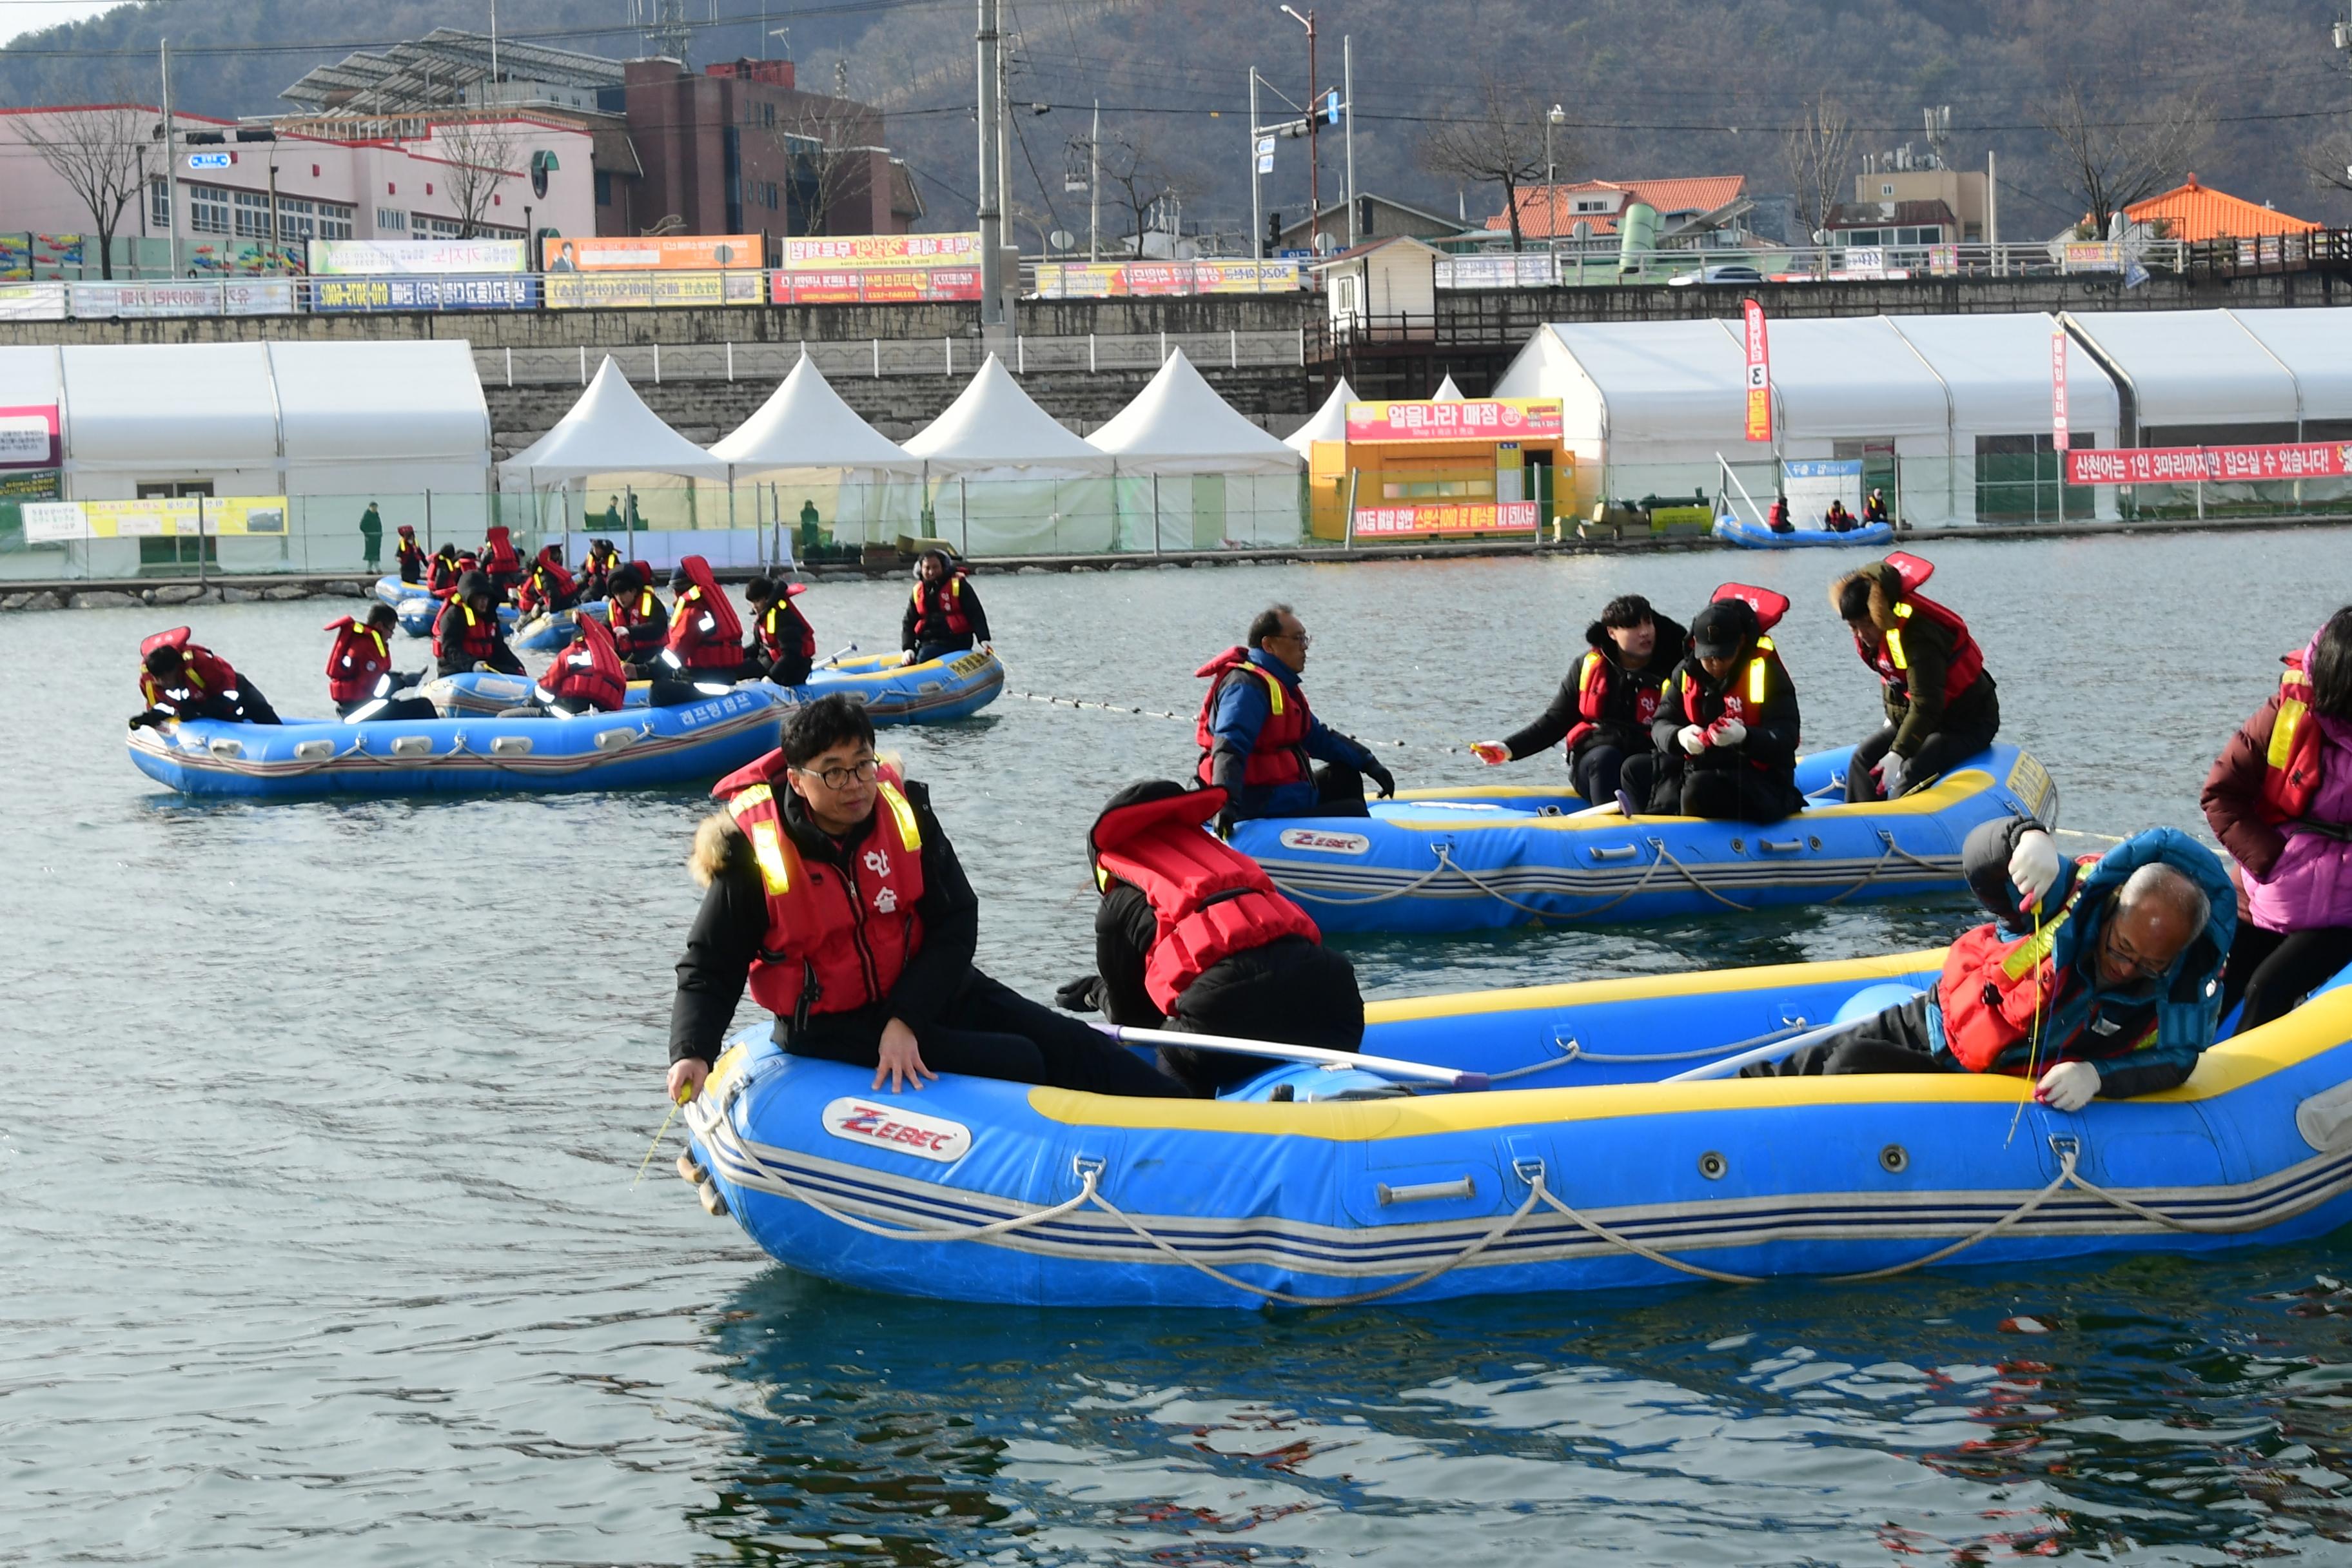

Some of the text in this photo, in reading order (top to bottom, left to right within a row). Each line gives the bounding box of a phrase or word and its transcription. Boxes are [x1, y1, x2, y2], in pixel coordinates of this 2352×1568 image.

[1388, 405, 1458, 428] 얼음나라
[1463, 404, 1498, 426] 매점
[2075, 447, 2329, 480] 산천어는 1인 3마리까지만 잡으실 수 있습니다!
[680, 692, 752, 726] 래프팅 캠프
[1292, 830, 1362, 850] ZEBEC
[838, 1106, 957, 1152] ZEBEC
